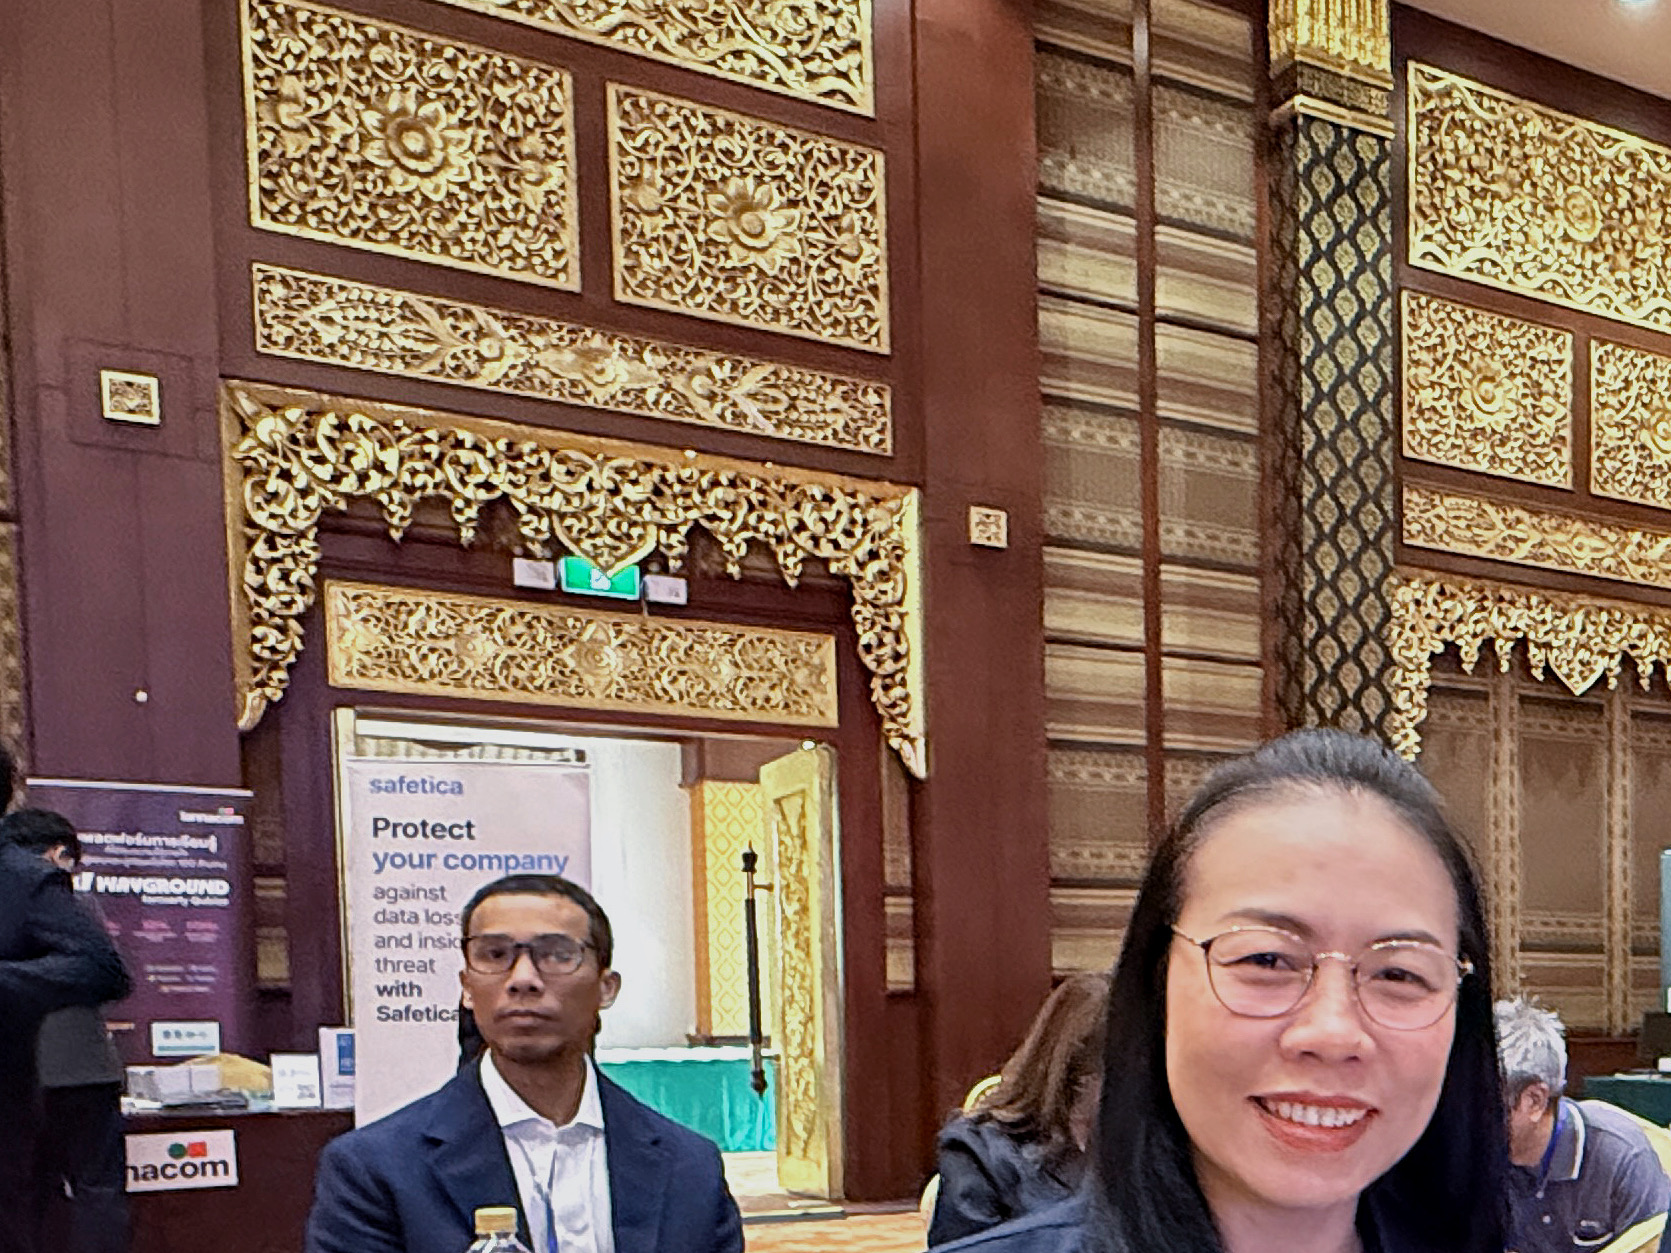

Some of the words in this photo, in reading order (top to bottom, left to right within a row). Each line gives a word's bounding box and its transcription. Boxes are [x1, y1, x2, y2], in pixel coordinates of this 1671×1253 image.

[369, 776, 464, 795] safetica
[372, 816, 476, 840] Protect
[372, 852, 437, 874] your
[443, 853, 569, 876] company
[373, 883, 448, 904] against
[374, 908, 419, 925] data
[374, 932, 413, 949] and
[374, 957, 436, 973] threat
[376, 980, 422, 998] with
